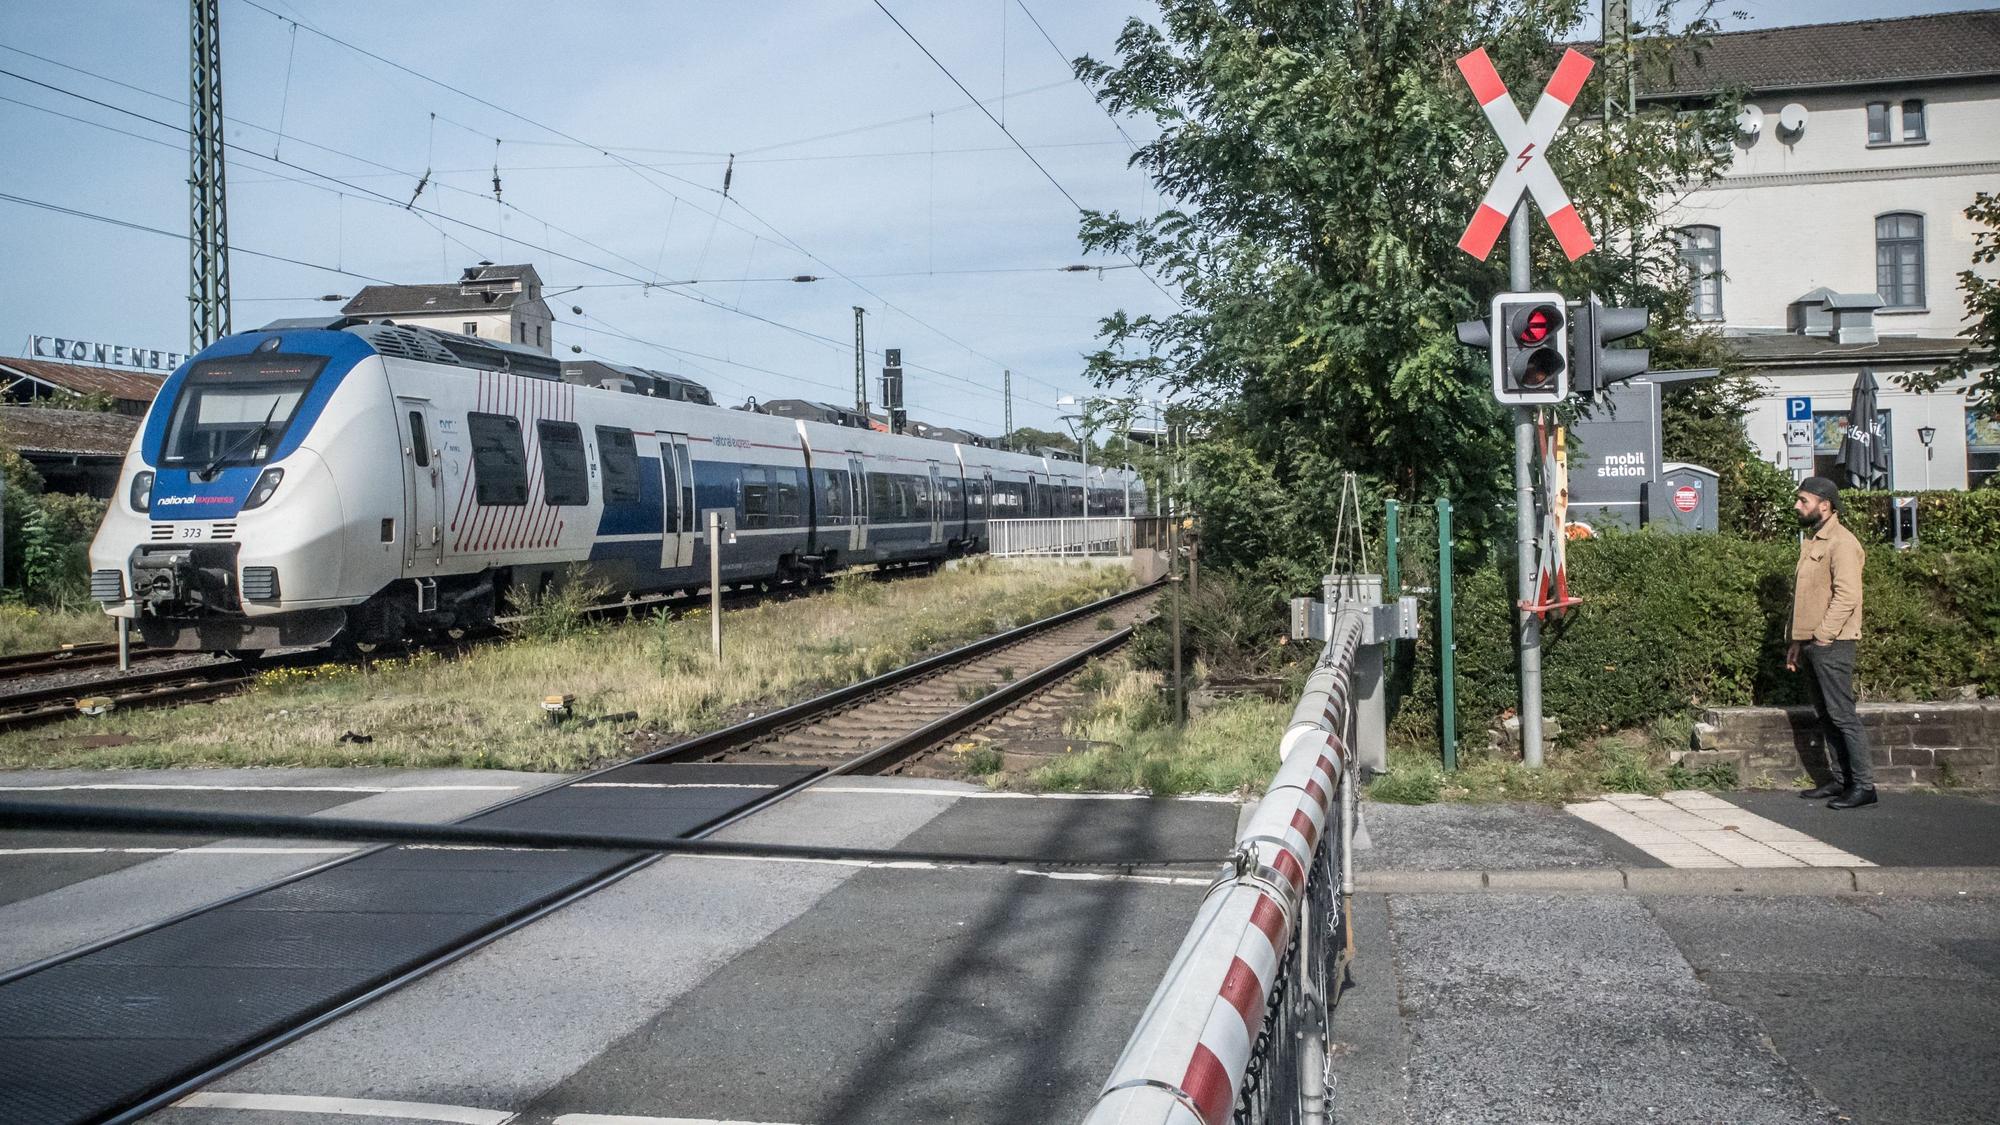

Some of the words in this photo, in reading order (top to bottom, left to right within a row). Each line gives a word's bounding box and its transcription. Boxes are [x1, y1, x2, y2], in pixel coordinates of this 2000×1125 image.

[1792, 400, 1806, 418] P
[1605, 452, 1645, 465] mobil
[1597, 464, 1646, 477] station
[182, 528, 202, 538] 373
